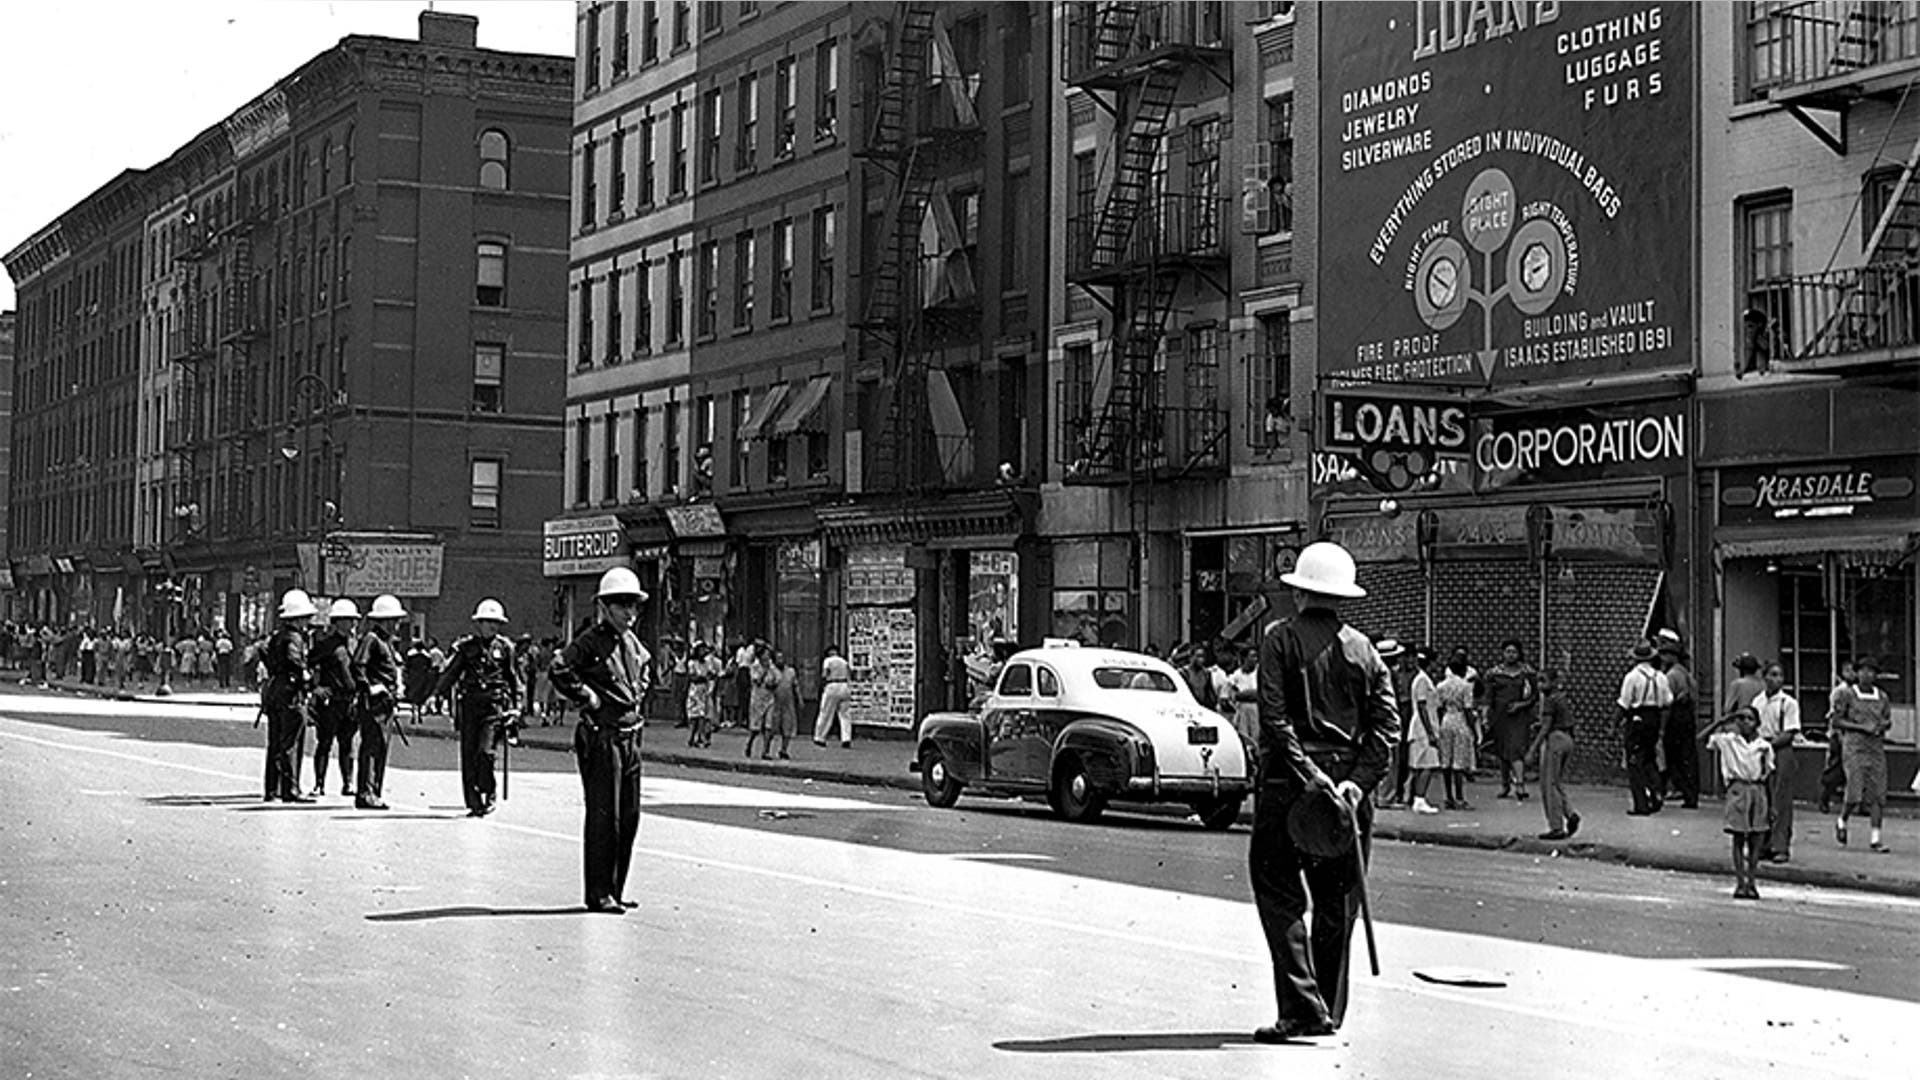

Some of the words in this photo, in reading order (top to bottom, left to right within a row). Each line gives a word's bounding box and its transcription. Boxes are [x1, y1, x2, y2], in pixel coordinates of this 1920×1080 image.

[1556, 7, 1662, 56] CLOTHING
[1565, 39, 1662, 85] LUGGAGE
[1342, 70, 1432, 114] DIAMONDS
[1584, 72, 1663, 111] FURS
[1342, 103, 1420, 142] JEWELRY
[1342, 130, 1433, 172] SILVERWARE
[1369, 168, 1436, 266] EVERYTHING
[1432, 138, 1483, 180] STORED
[1485, 130, 1502, 153] IN
[1505, 130, 1584, 181] INDIVIDUAL
[1582, 165, 1623, 220] BAGS
[1421, 219, 1450, 244] TIME
[1470, 210, 1508, 233] PLACE
[1522, 201, 1551, 220] RIGHT
[1549, 204, 1581, 297] TEMPERATURE
[1524, 310, 1589, 339] BUILDING
[1588, 311, 1608, 331] and
[1609, 300, 1656, 327] VAULT
[1356, 342, 1384, 363] FIRE
[1393, 334, 1440, 358] PROOF
[1403, 352, 1473, 380] PROTECTION
[1504, 343, 1549, 368] ISAACS
[1553, 333, 1637, 364] ESTABLISHED
[1638, 327, 1673, 352] 1891
[1332, 400, 1467, 446] LOANS
[1475, 414, 1684, 472] CORPORATION
[1754, 472, 1873, 508] KRASDALE
[544, 531, 619, 560] BUTTERCUP
[368, 555, 439, 581] SHOES
